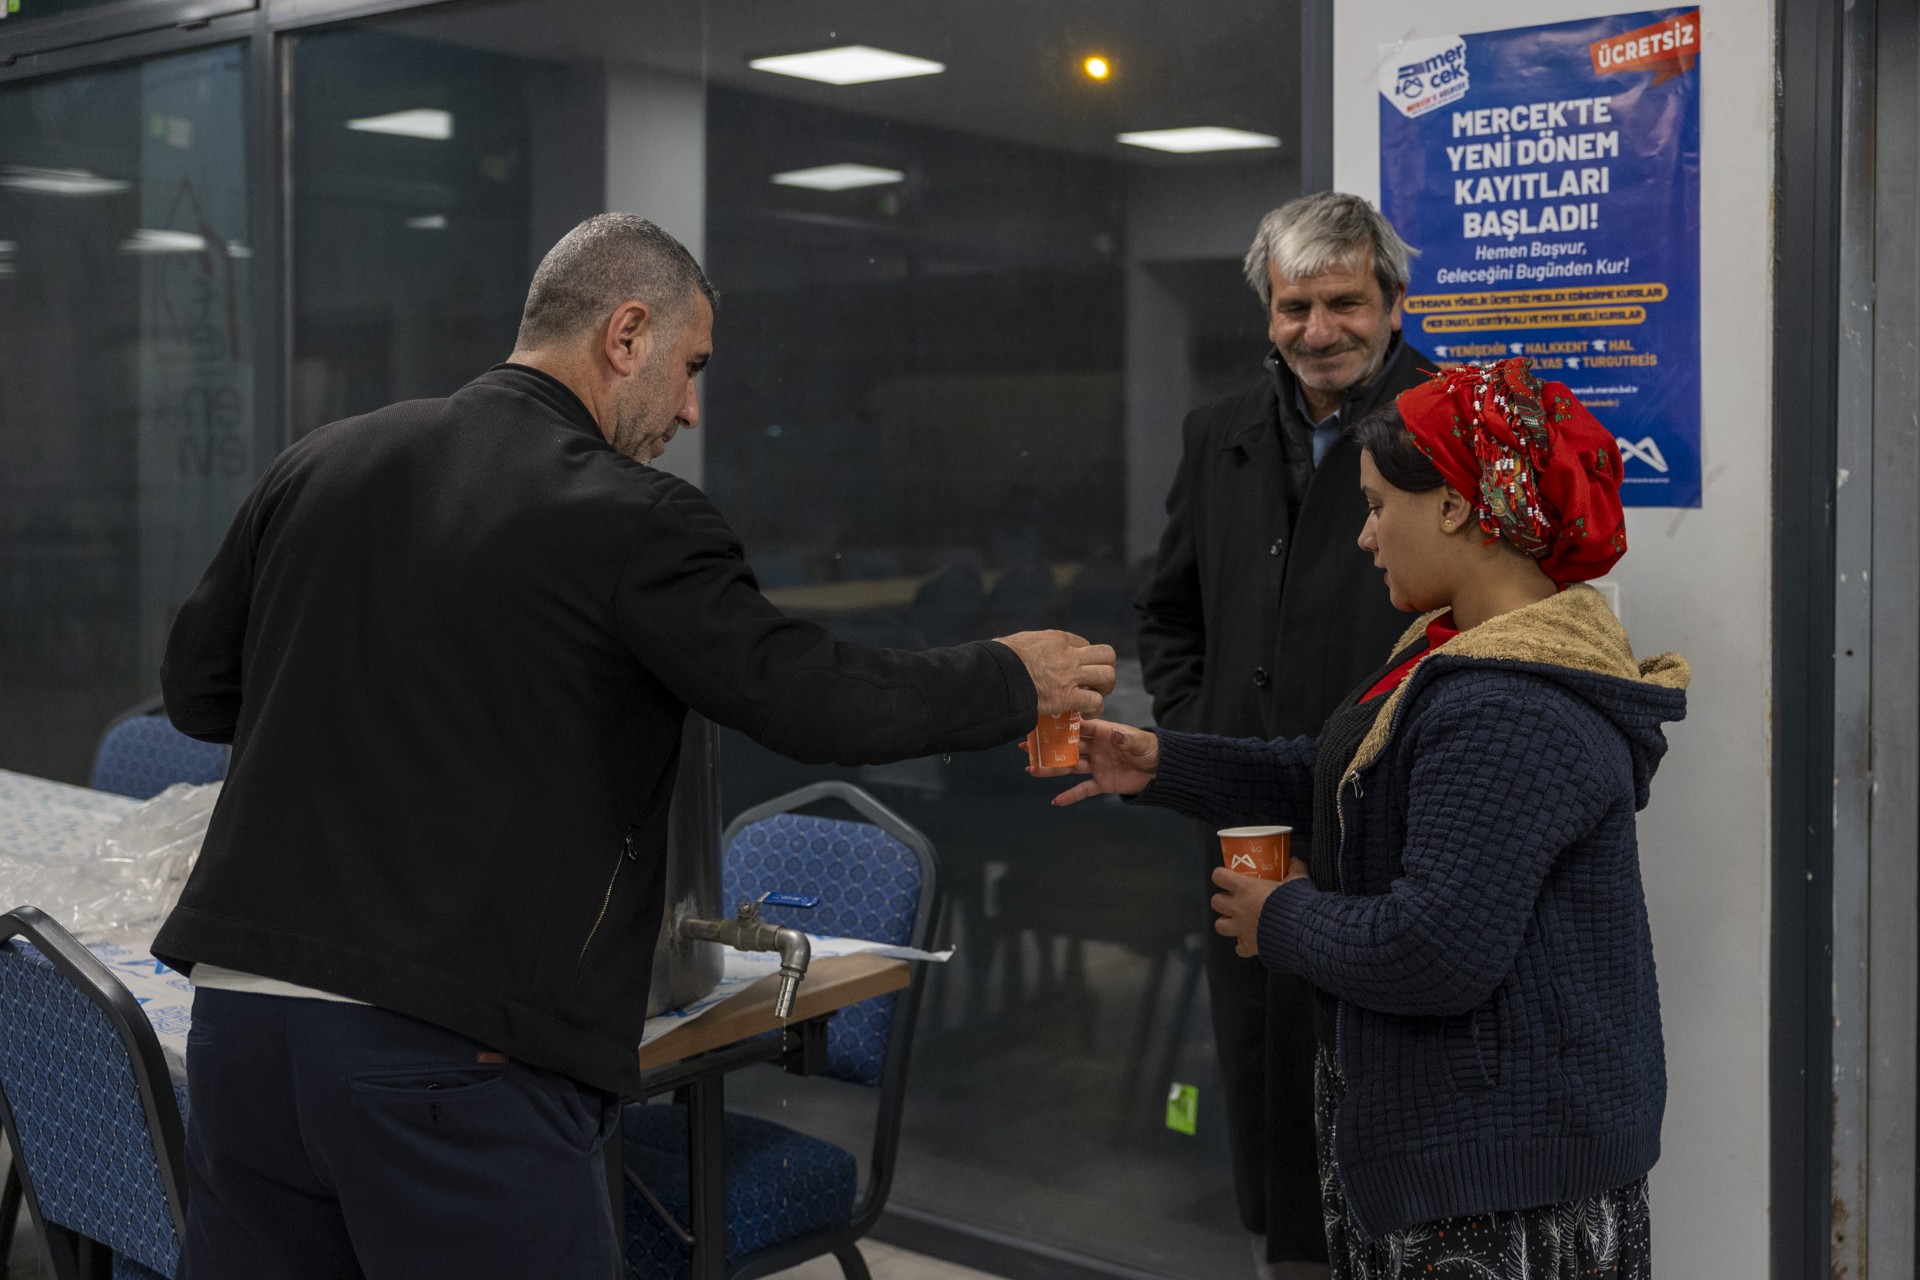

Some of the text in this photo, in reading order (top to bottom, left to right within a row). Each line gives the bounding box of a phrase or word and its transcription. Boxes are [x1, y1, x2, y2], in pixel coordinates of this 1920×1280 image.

[1425, 44, 1463, 73] mer
[1598, 21, 1694, 68] ÜCRETSİZ
[1430, 63, 1465, 88] cek
[1452, 96, 1612, 138] MERCEK'TE
[1446, 130, 1619, 172] YENİ DÖNEM
[1454, 166, 1609, 205] KAYITLARI
[1463, 203, 1598, 242] BAŞLADI!
[1475, 241, 1587, 261] Hemen Başvur,
[1436, 257, 1630, 285] Geleceğini Bugünden Kur!
[1448, 342, 1507, 358] YENİŞEHİR
[1525, 341, 1589, 355] HALKKENT
[1582, 352, 1658, 369] TURGUTREİS
